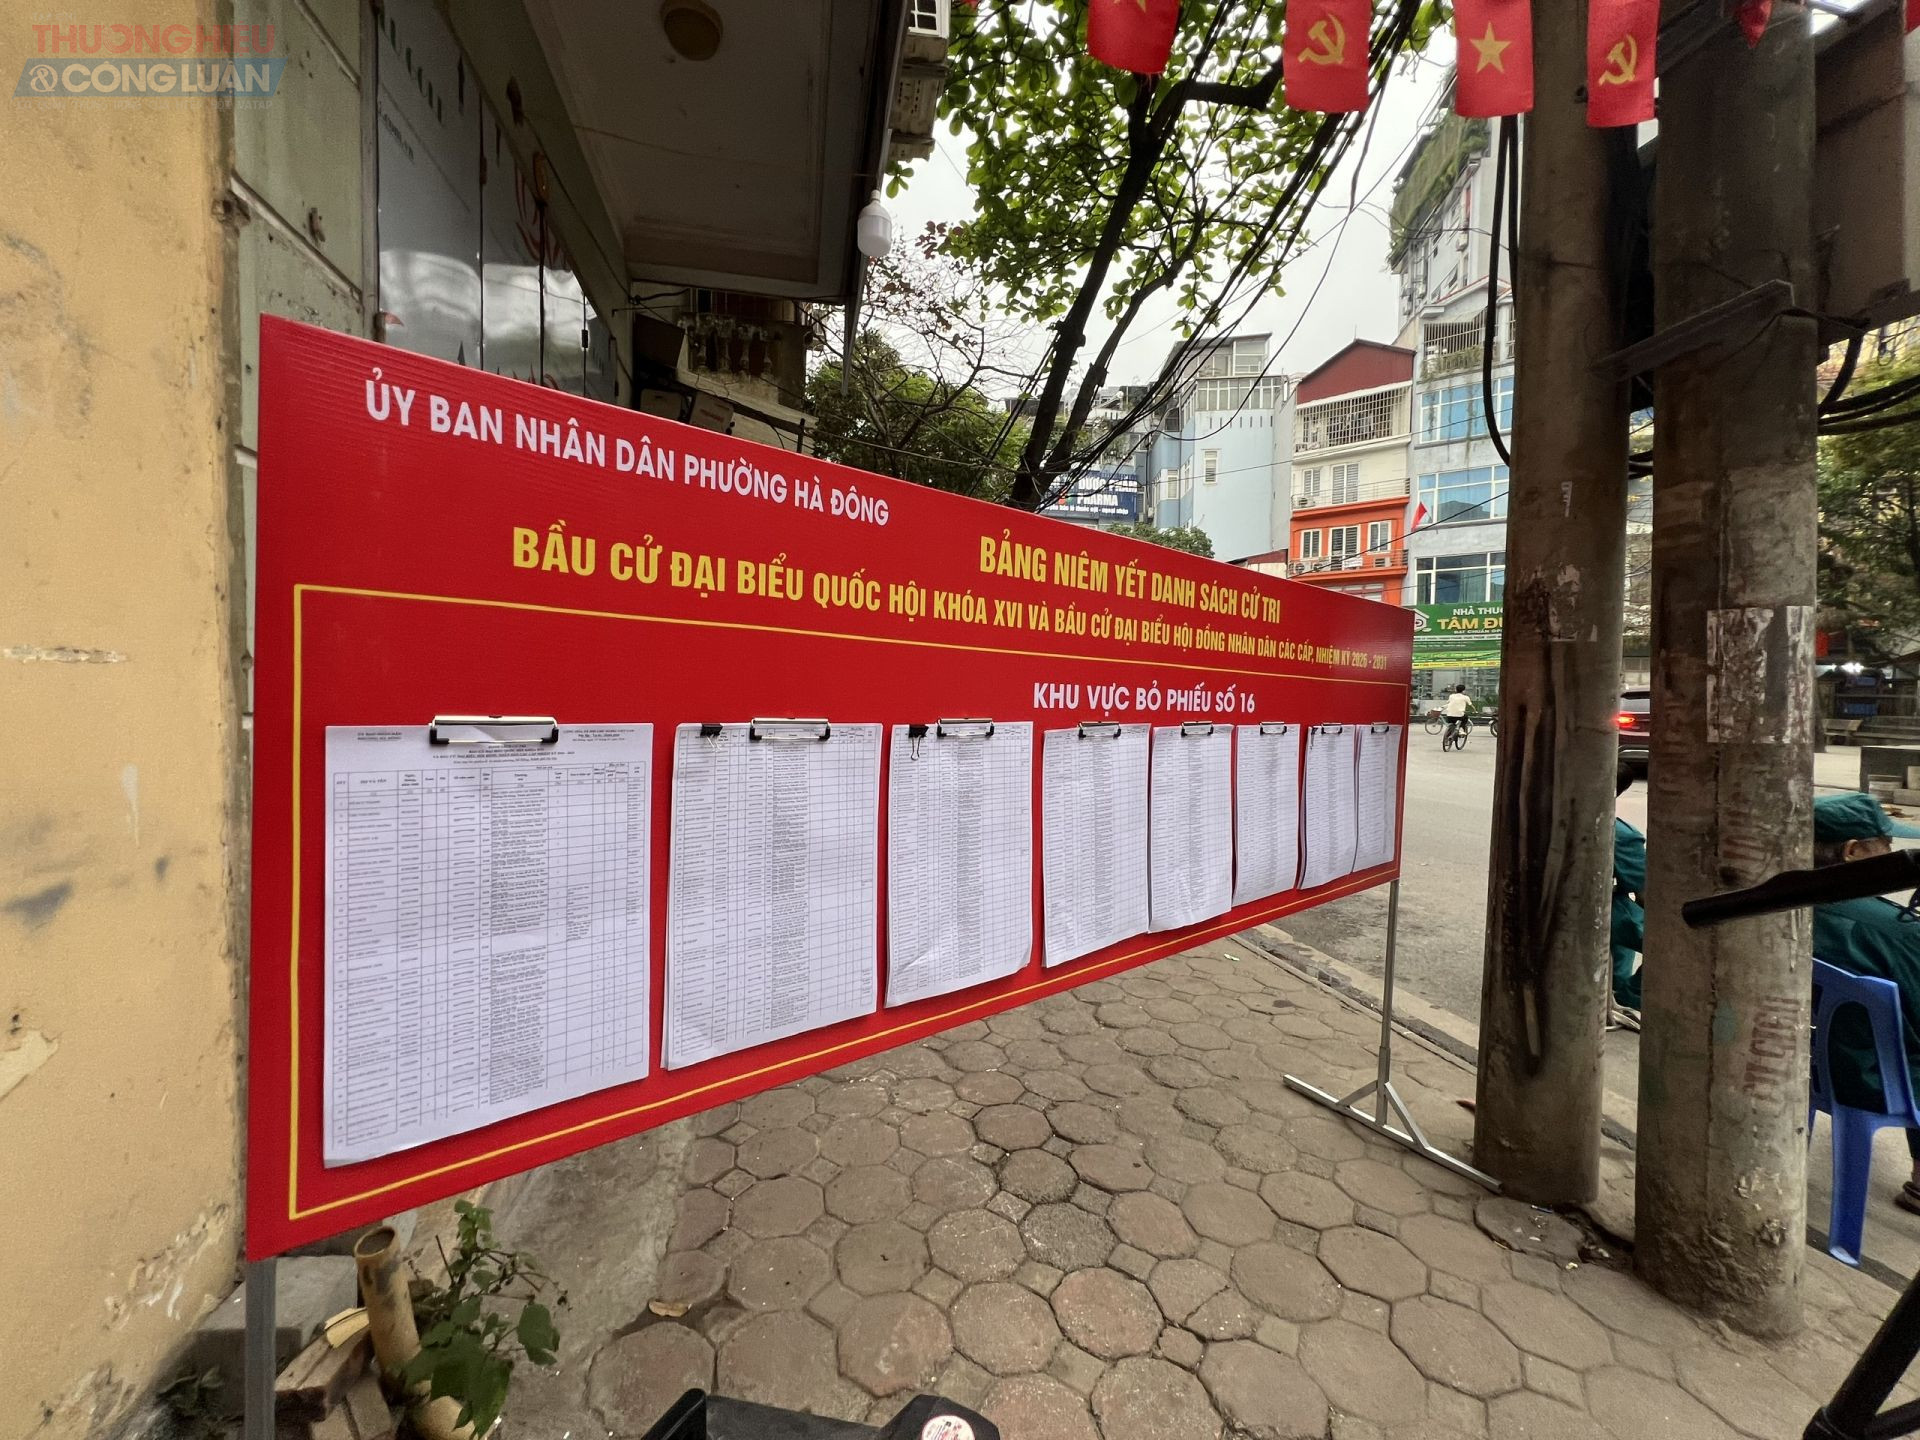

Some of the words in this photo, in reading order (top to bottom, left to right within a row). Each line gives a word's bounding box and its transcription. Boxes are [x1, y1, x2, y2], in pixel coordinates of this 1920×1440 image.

[365, 367, 416, 425] ỦY
[430, 395, 502, 444] BAN
[516, 414, 605, 467] NHÂN
[616, 435, 675, 482] DÂN
[684, 453, 788, 504] PHƯỜNG
[794, 475, 824, 511] HÀ
[831, 485, 889, 527] ĐÔNG
[513, 519, 596, 577] BẦU
[610, 534, 663, 585] CỬ
[670, 551, 725, 598] ĐẠI
[737, 552, 803, 601] BIỂU
[813, 567, 881, 612] QUỐC
[889, 580, 926, 623] HỘI
[933, 585, 987, 626] KHÓA
[993, 599, 1022, 630] XVI
[1028, 597, 1049, 633] VÀ
[1054, 601, 1085, 636] BẦU
[1091, 608, 1113, 639] CỬ
[1114, 616, 1138, 645] ĐẠI
[1141, 615, 1170, 646] BIỂU
[1173, 622, 1192, 653] HỘI
[1196, 624, 1225, 651] ĐỒNG
[1228, 632, 1255, 655] NHÂN
[1258, 633, 1276, 658] DÂN
[1279, 638, 1295, 660] CÁC
[1297, 638, 1314, 664] CẤP,
[1316, 645, 1340, 670] NHIỆM
[1352, 652, 1367, 669] 2026
[1373, 656, 1386, 670] 2031
[980, 528, 1046, 583] BẢNG
[1054, 550, 1108, 588] NIÊM
[1115, 559, 1147, 599] YẾT
[1151, 572, 1195, 609] DANH
[1200, 579, 1237, 614] SÁCH
[1241, 586, 1260, 621] CỬ
[1262, 596, 1280, 624] TRI
[1437, 616, 1478, 629] TÂM
[1478, 607, 1503, 615] THU
[1033, 681, 1079, 709] KHU
[1087, 684, 1130, 717] VỰC
[1135, 680, 1161, 711] BỎ
[1167, 682, 1210, 713] PHIẾU
[1215, 682, 1236, 713] SỐ
[1240, 692, 1255, 713] 16
